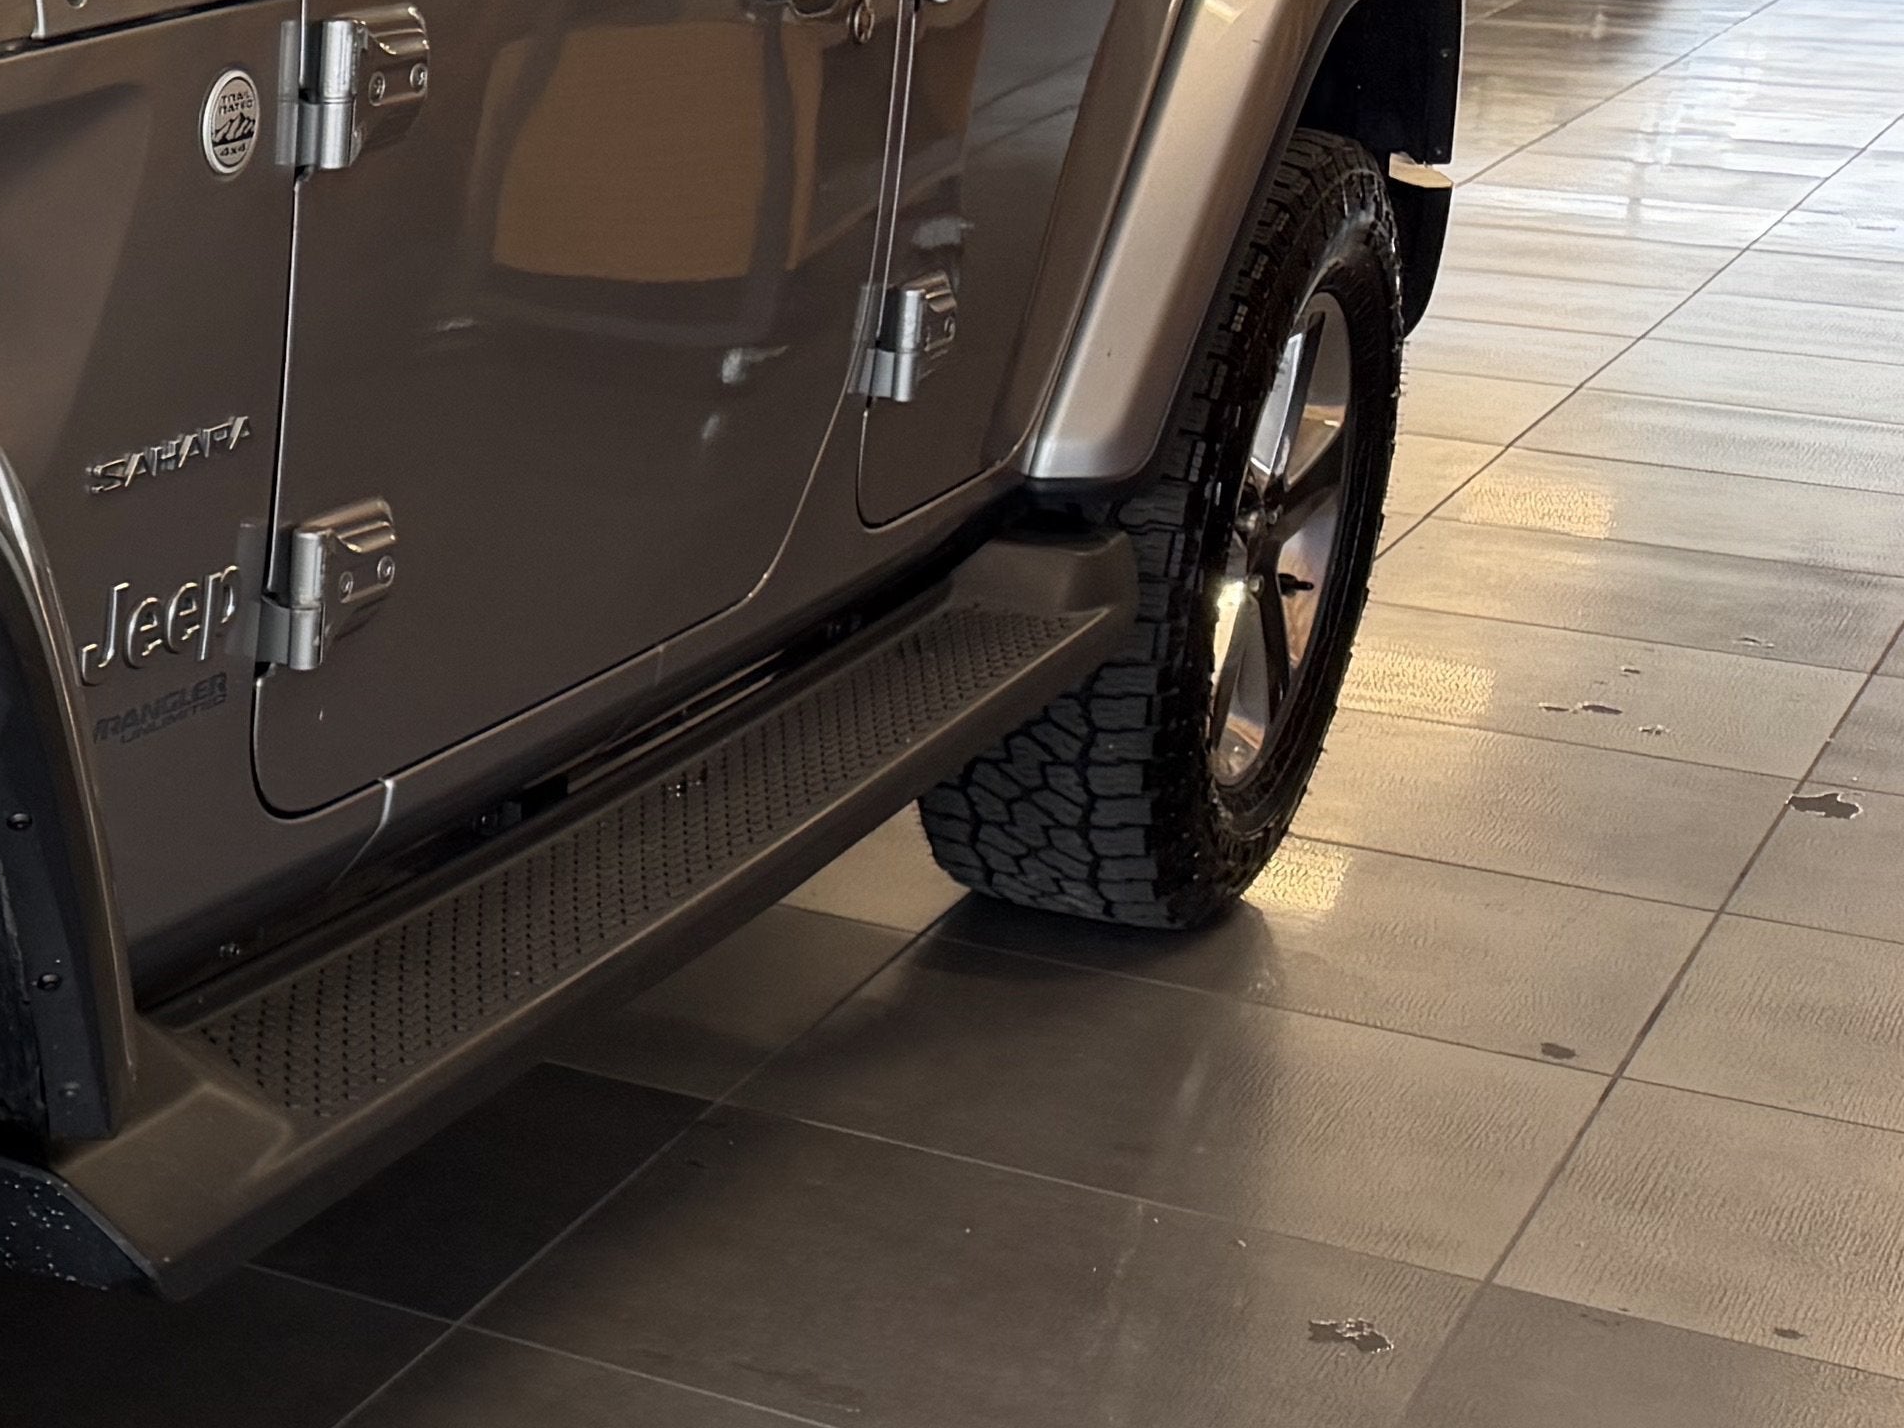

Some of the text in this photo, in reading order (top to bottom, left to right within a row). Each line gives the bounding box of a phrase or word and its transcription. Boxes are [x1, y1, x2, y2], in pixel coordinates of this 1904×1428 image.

[218, 99, 254, 115] RATED
[220, 91, 251, 104] TRAIL
[87, 416, 253, 494] SAHARA
[79, 564, 242, 687] Jeep
